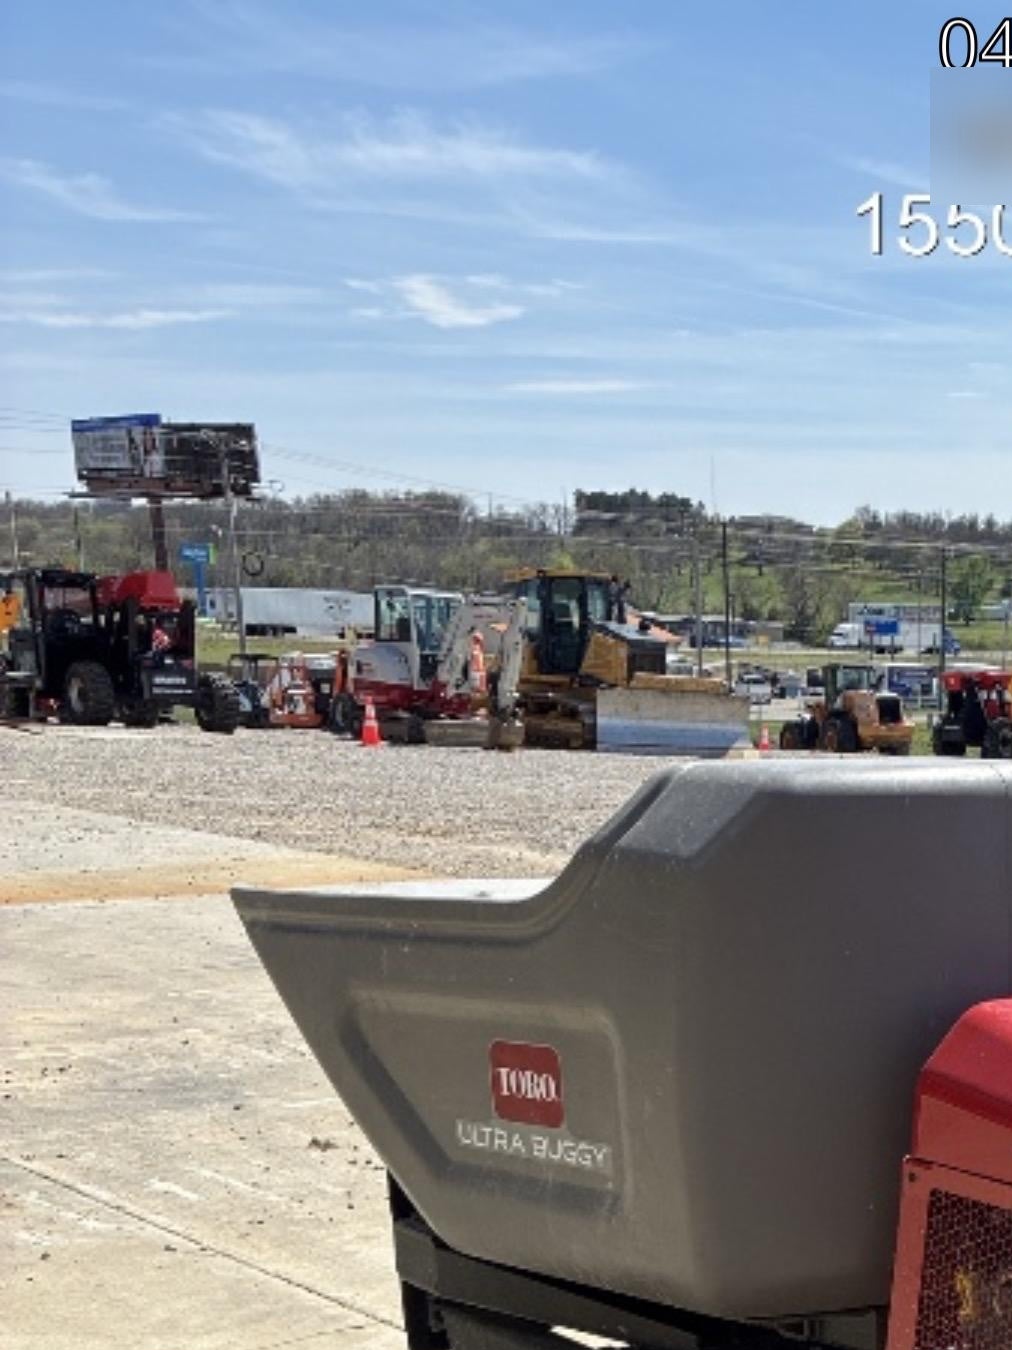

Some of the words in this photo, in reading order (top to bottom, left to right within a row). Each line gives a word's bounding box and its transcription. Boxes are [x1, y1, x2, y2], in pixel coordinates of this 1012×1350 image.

[496, 1067, 559, 1102] TORO
[456, 1119, 526, 1154] ULTRA
[531, 1135, 609, 1168] BUGGY
